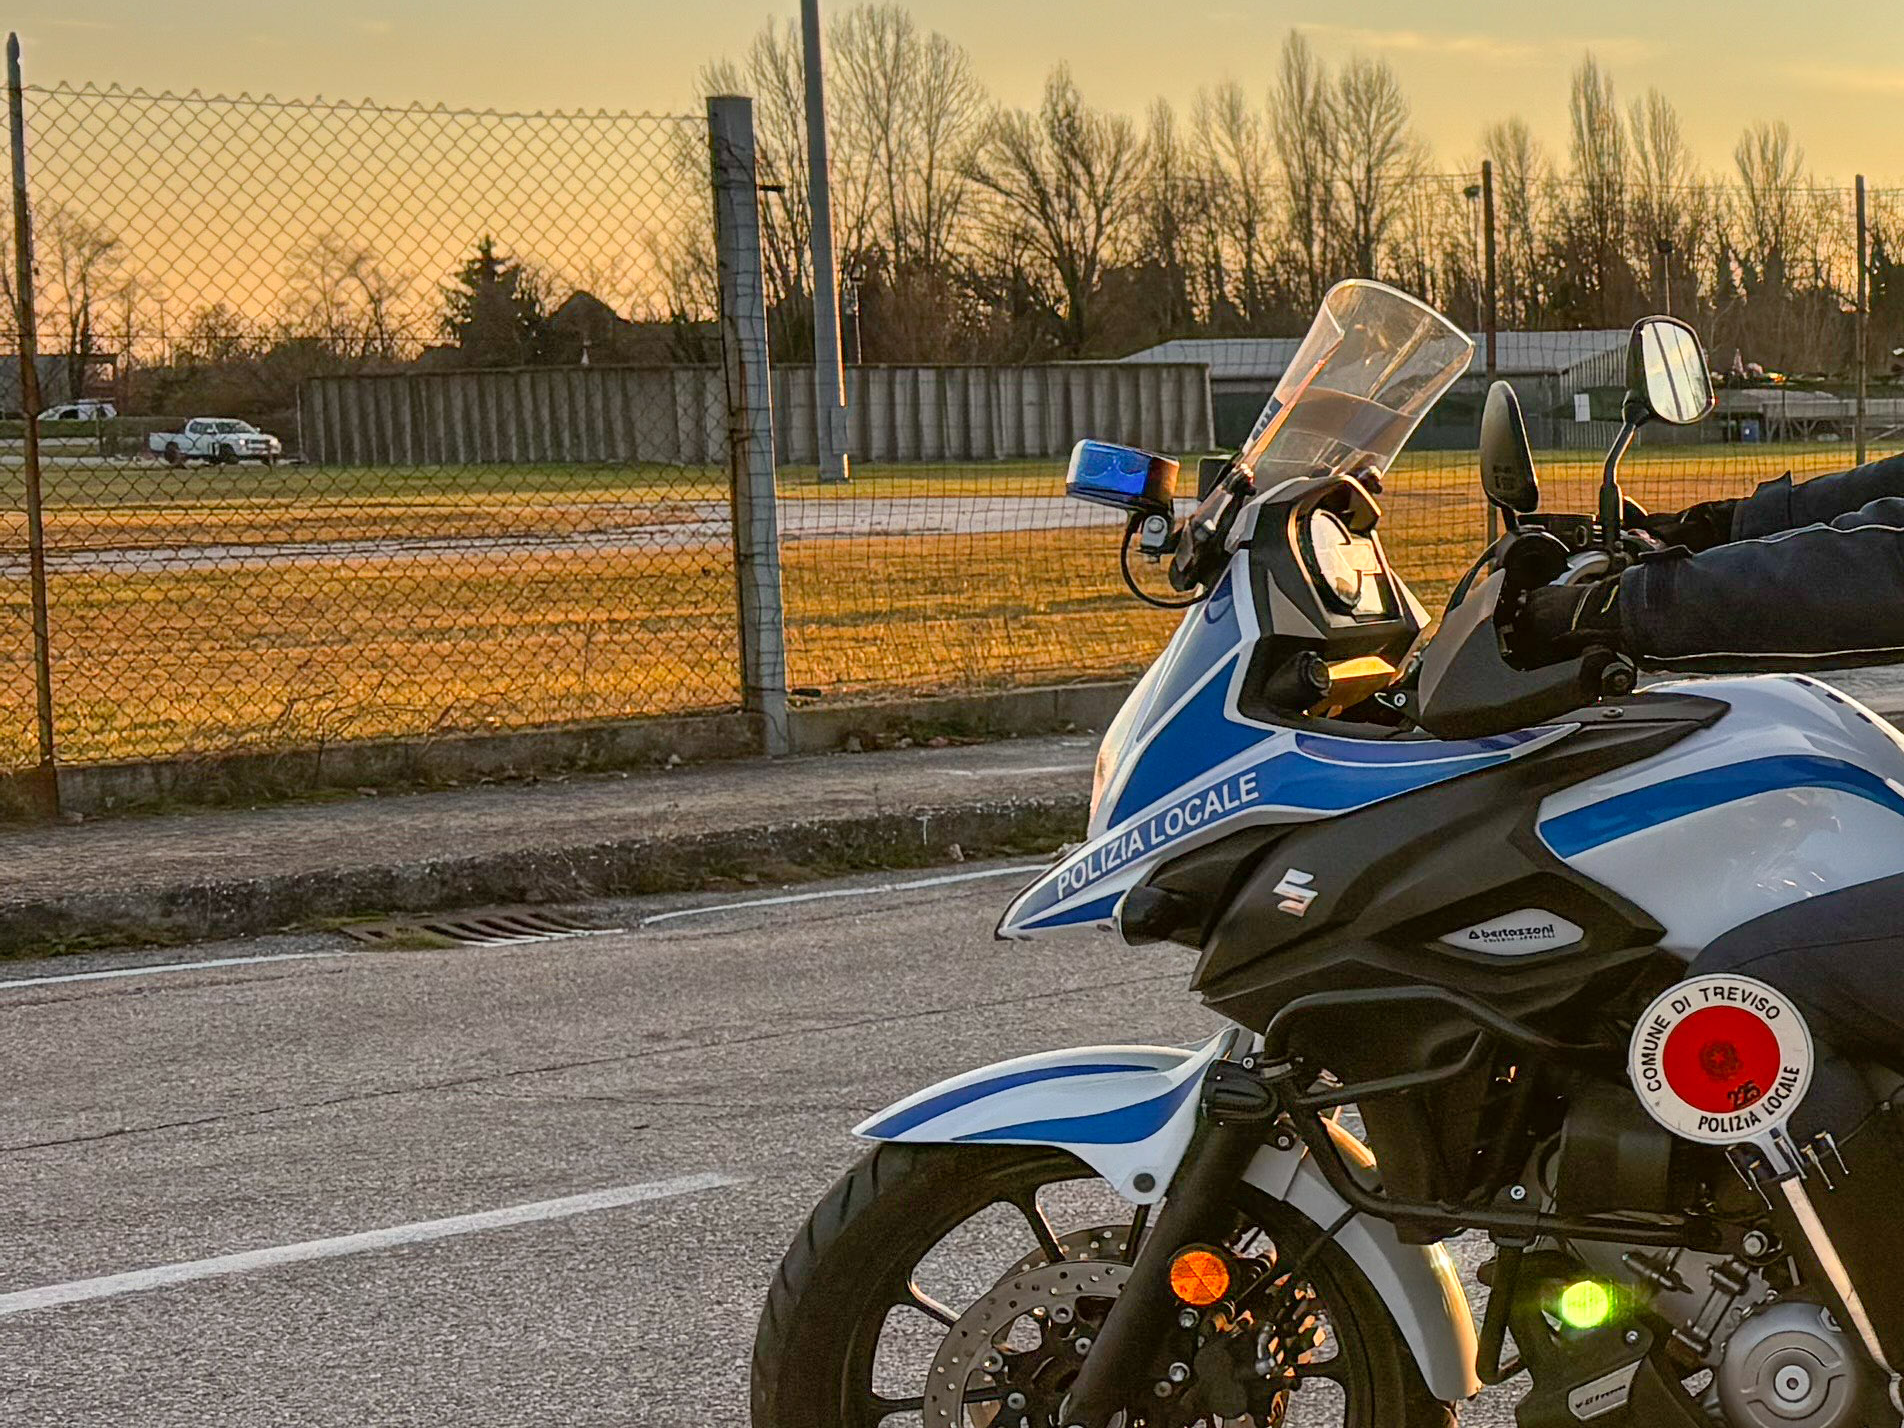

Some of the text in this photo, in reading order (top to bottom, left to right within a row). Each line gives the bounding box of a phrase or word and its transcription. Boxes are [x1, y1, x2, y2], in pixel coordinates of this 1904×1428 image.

[1056, 771, 1260, 900] POLIZIA LOCALE
[1641, 986, 1780, 1092] COMUNE DI TREVISO
[1697, 1065, 1800, 1133] POLIZIA LOCALE
